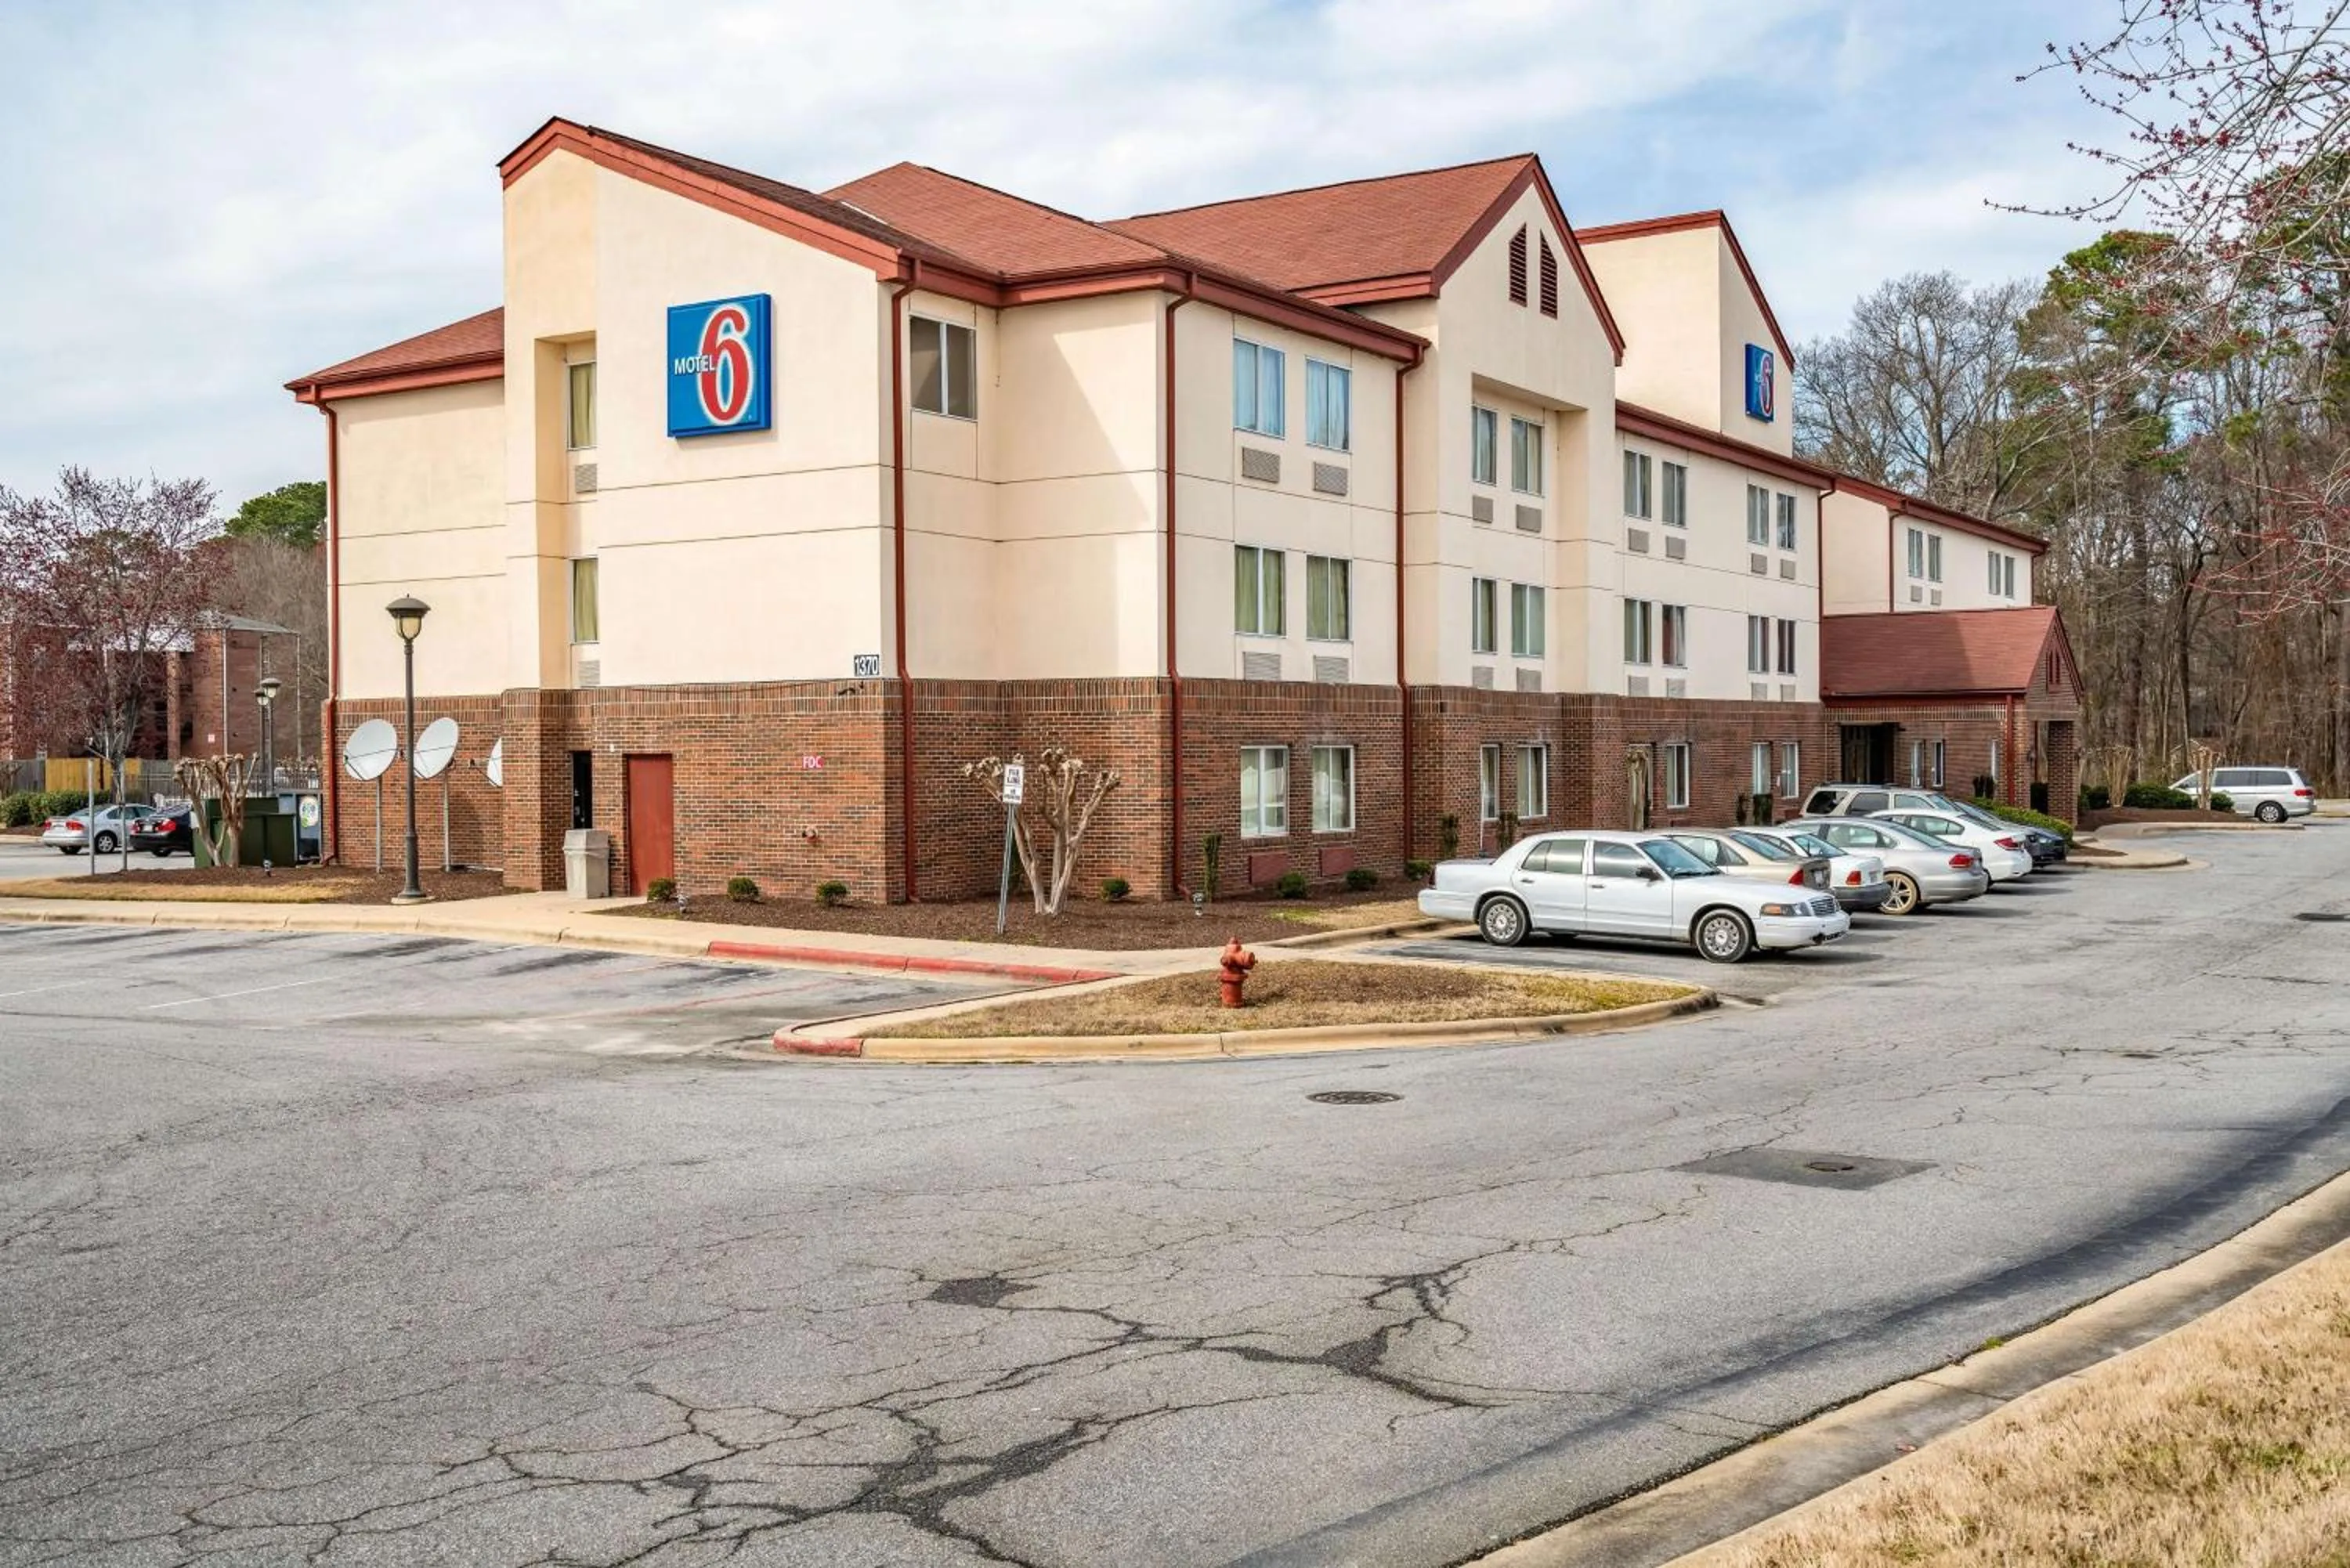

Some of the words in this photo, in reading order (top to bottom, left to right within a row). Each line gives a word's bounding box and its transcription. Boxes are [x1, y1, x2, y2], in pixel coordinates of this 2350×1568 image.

[674, 355, 716, 375] MOTEL
[698, 305, 752, 424] 6
[855, 656, 878, 675] 1370
[803, 756, 822, 768] FDC
